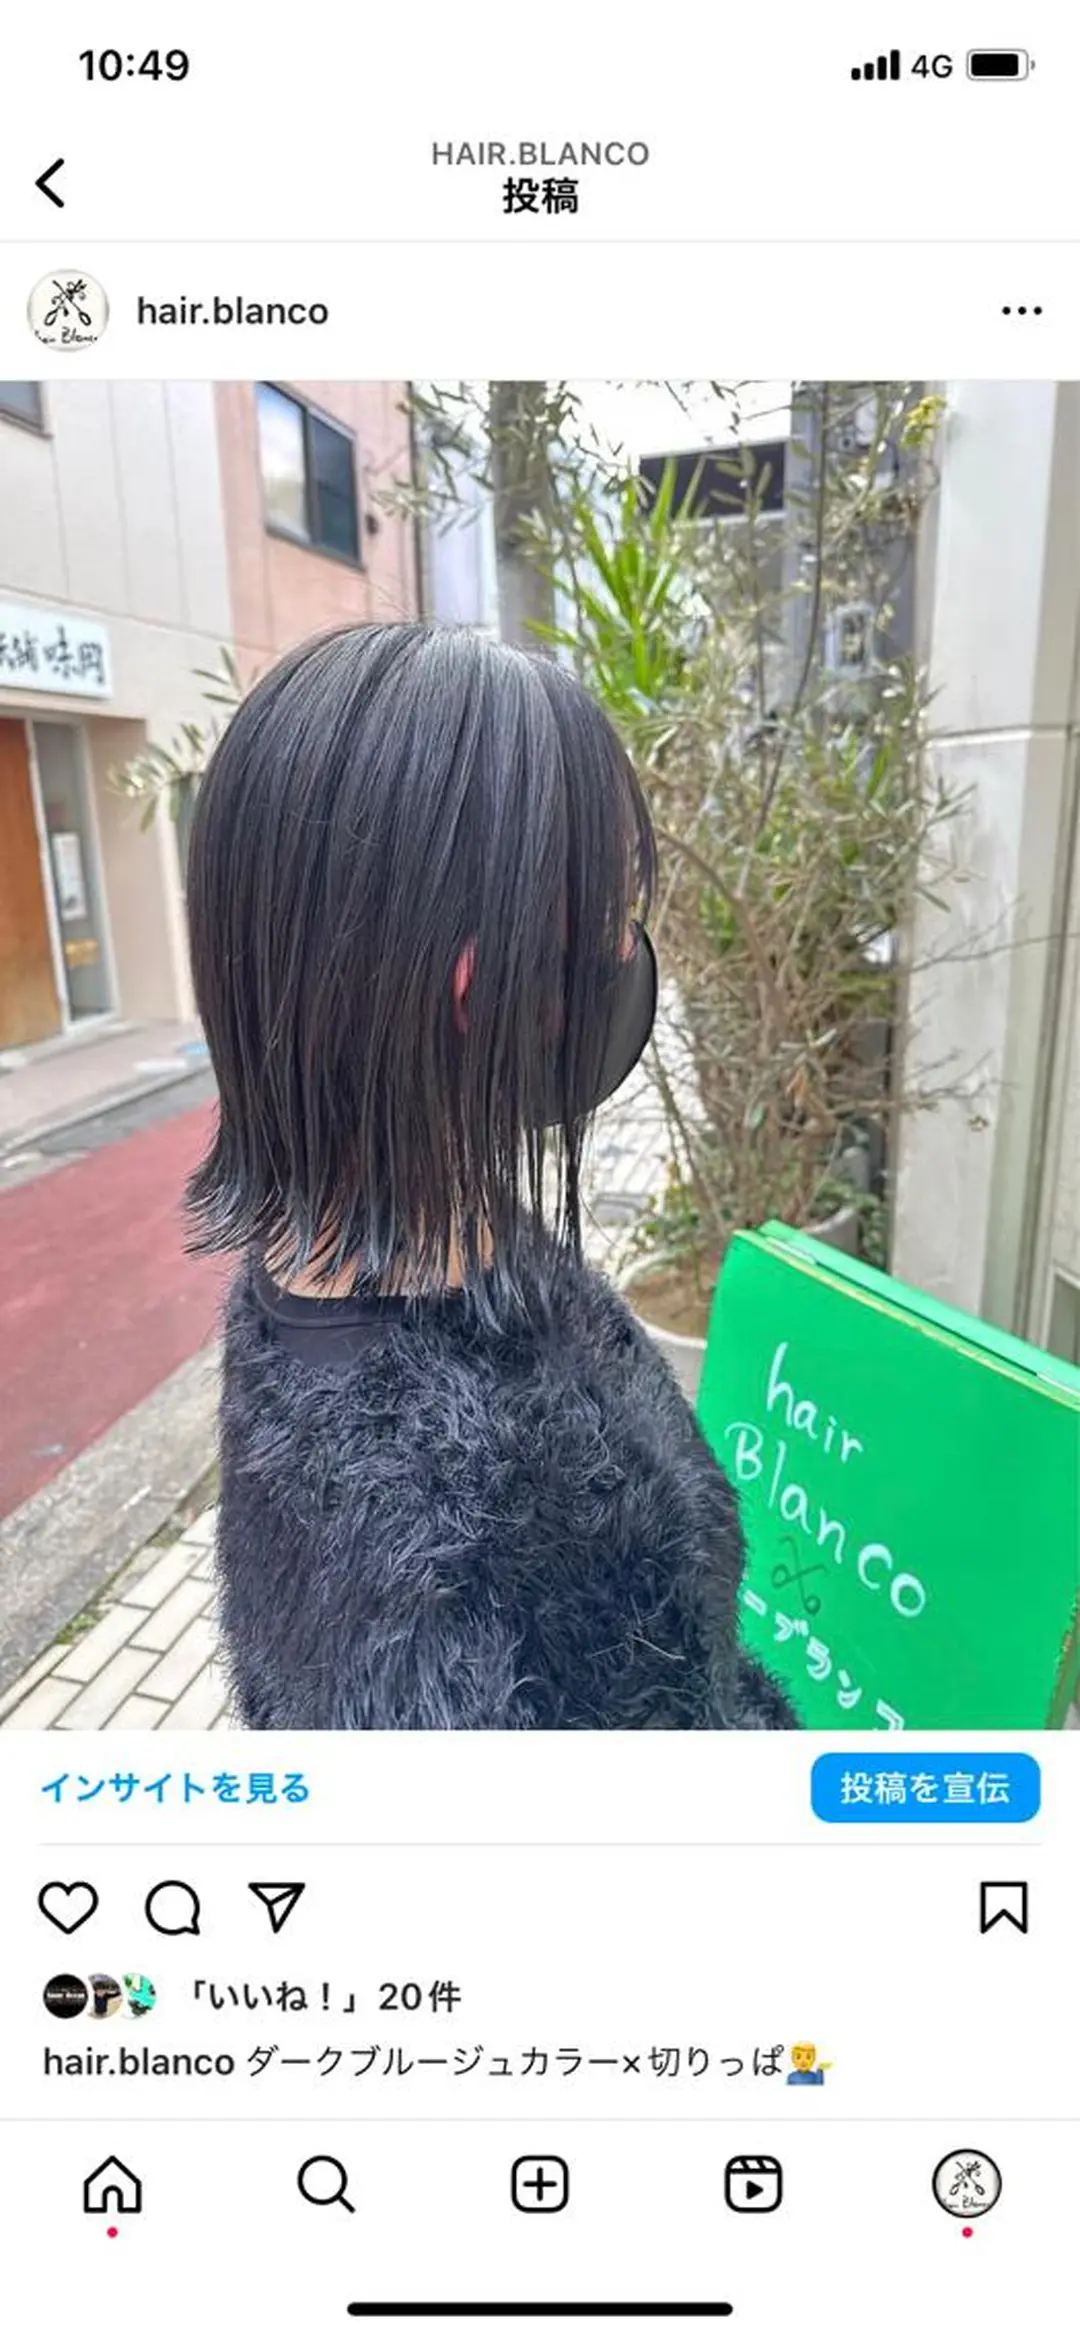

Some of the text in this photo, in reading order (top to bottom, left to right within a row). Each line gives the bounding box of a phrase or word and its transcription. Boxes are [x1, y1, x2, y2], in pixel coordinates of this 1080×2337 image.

[79, 48, 190, 82] 10:49
[911, 54, 953, 79] 4G
[432, 141, 649, 166] HAIR.BLANCO
[502, 176, 579, 215] 投稿
[138, 295, 329, 325] hair.blanco
[765, 1341, 864, 1464] hair
[723, 1421, 927, 1618] Blanco
[41, 1771, 310, 1805] インサイトを見る
[841, 1771, 1009, 1805] 投稿を宣伝
[44, 2044, 235, 2076] hair.blanco
